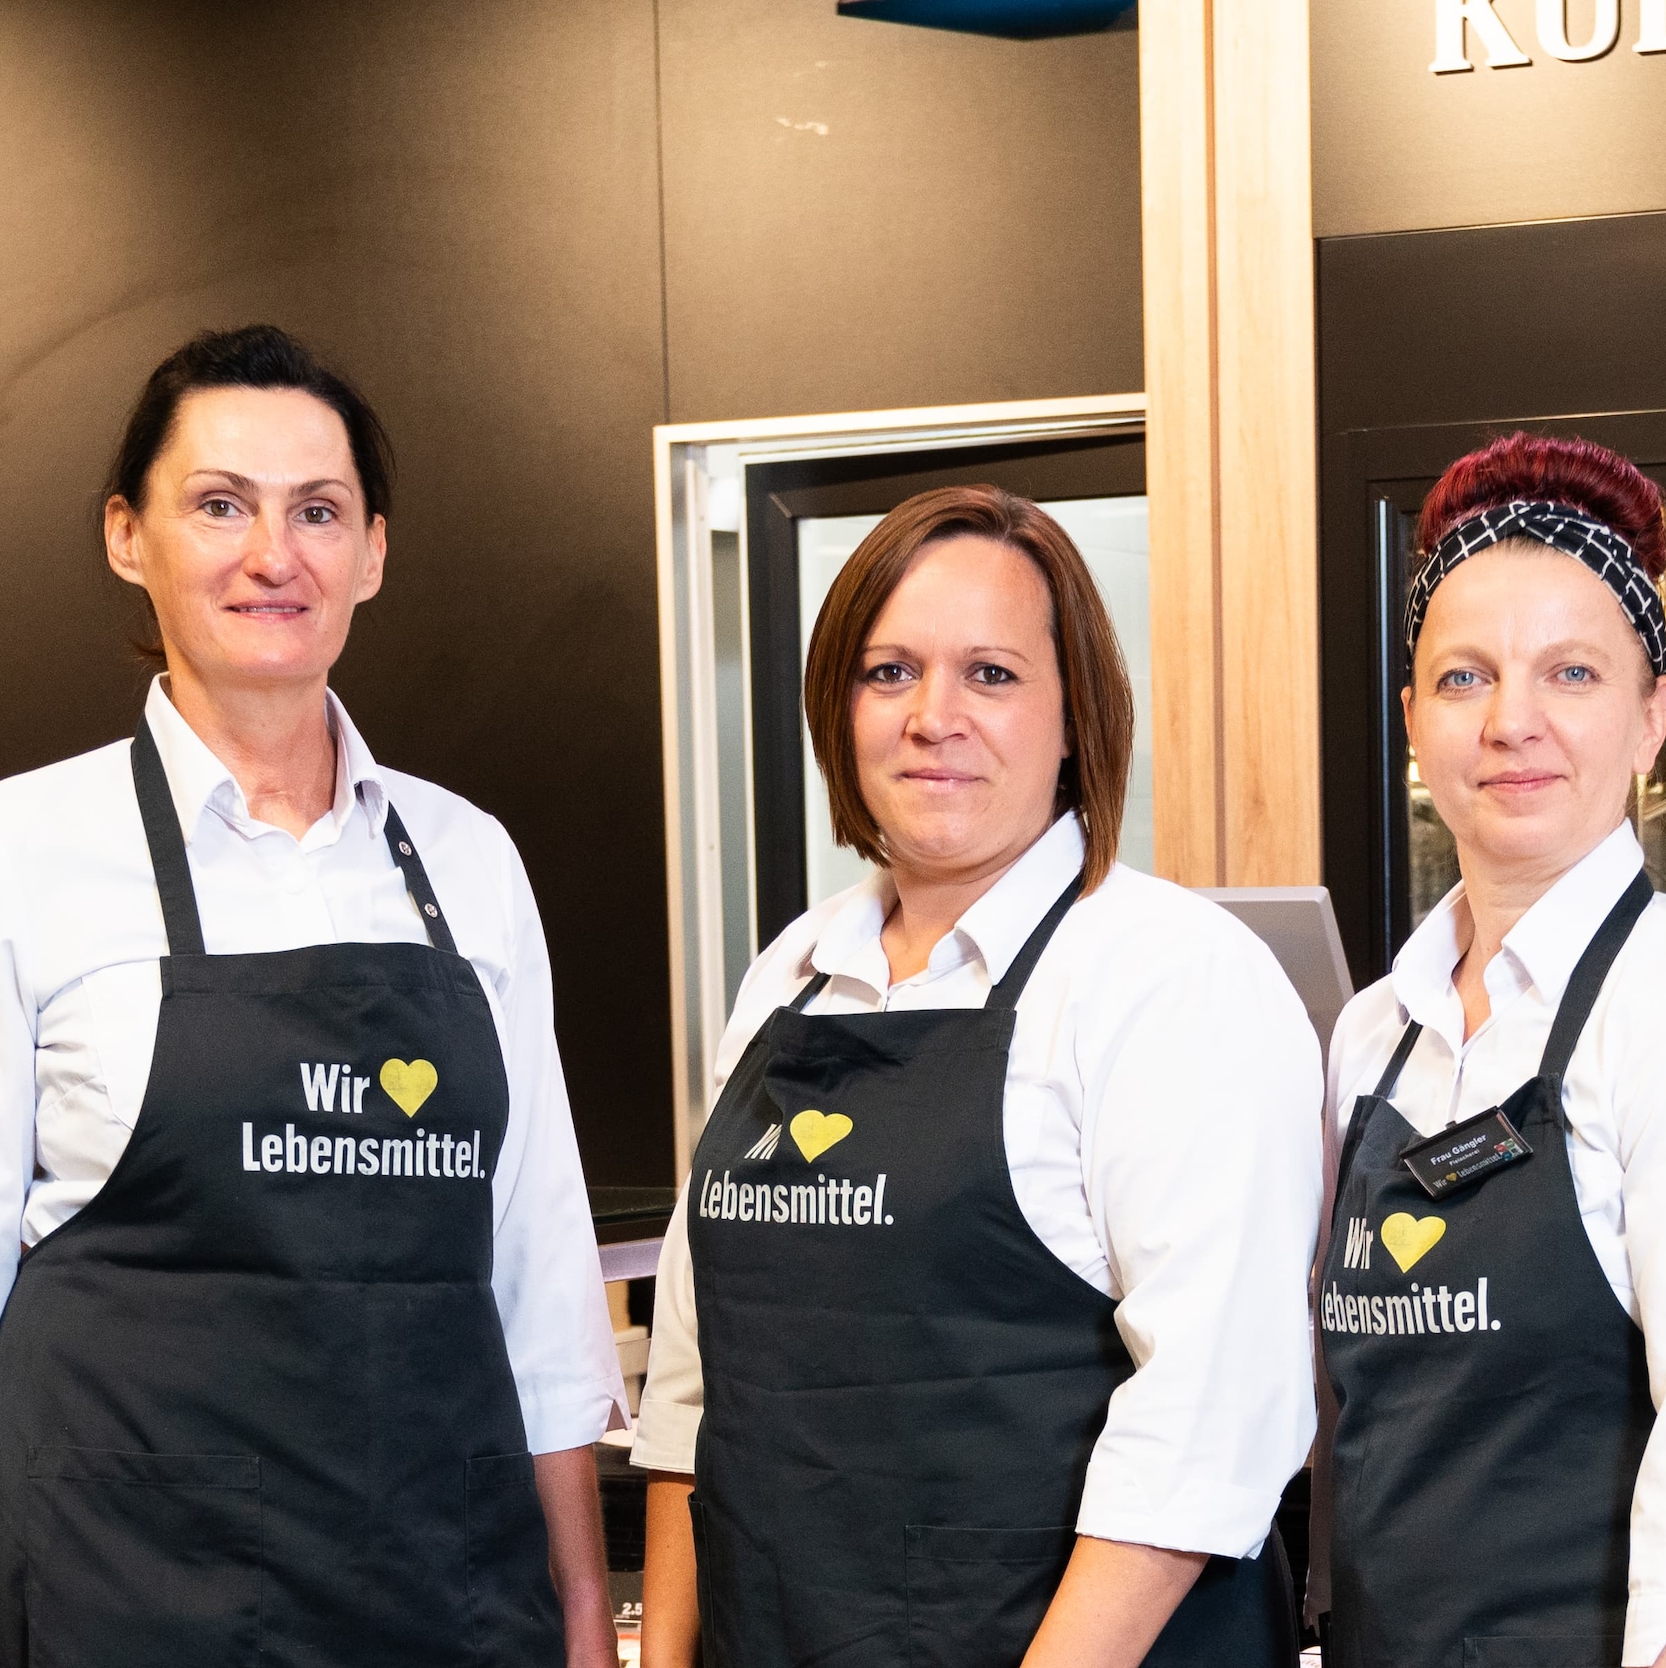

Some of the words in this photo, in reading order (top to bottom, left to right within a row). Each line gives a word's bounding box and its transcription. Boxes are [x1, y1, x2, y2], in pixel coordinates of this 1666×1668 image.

[300, 1062, 371, 1114] Wir
[242, 1121, 486, 1180] Lebensmittel.
[1430, 1151, 1452, 1166] Frau
[1452, 1134, 1487, 1155] Gängler
[700, 1170, 894, 1225] Lebensmittel.
[1321, 1277, 1501, 1334] Lebensmittel.
[622, 1602, 643, 1616] 2.5
